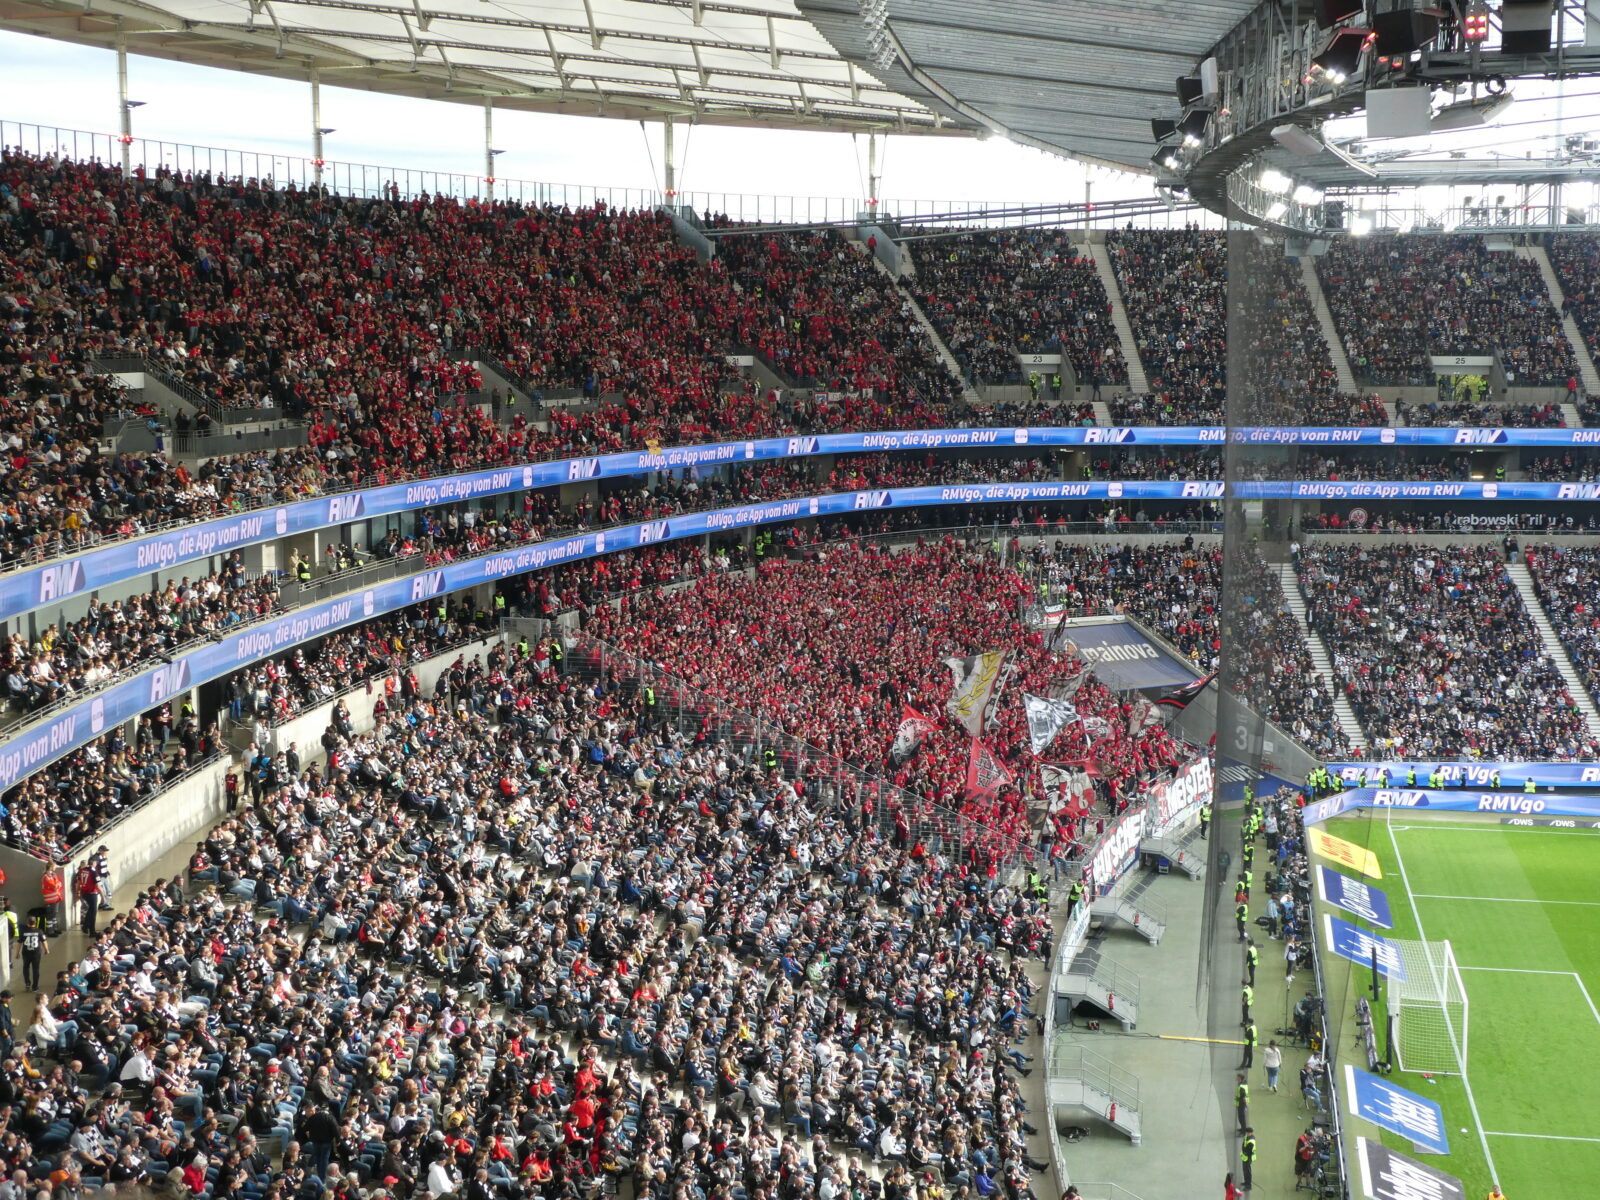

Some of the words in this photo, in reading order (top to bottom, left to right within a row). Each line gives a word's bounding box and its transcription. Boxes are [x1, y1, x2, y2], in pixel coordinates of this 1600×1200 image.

[903, 433, 918, 444] die
[921, 434, 941, 446] App
[944, 434, 969, 444] vom
[971, 430, 998, 443] RMV
[1084, 428, 1127, 443] RMV
[1250, 428, 1271, 441] die
[1272, 430, 1298, 444] App
[1301, 431, 1330, 441] vom
[1332, 430, 1362, 441] RMV
[1454, 429, 1503, 443] RMV
[670, 451, 681, 464] die
[683, 450, 697, 465] App
[699, 449, 716, 462] vom
[717, 445, 735, 459] RMV
[788, 438, 815, 454] RMV
[569, 459, 597, 479] RMV
[441, 480, 453, 497] die
[455, 480, 471, 497] App
[473, 478, 491, 492] vom
[492, 471, 512, 489] RMV
[987, 486, 1003, 497] die
[1007, 486, 1029, 499] App
[1032, 487, 1059, 497] vom
[1062, 484, 1091, 496] RMV
[1183, 483, 1224, 496] RMV
[1351, 484, 1371, 496] die
[1375, 485, 1399, 497] App
[1402, 486, 1431, 496] vom
[1434, 484, 1464, 496] RMV
[329, 495, 361, 522] RMV
[855, 491, 887, 508] RMV
[737, 510, 748, 522] die
[749, 508, 765, 524] App
[765, 506, 782, 520] vom
[783, 502, 800, 517] RMV
[179, 534, 194, 555] die
[196, 531, 215, 553] App
[218, 526, 238, 545] vom
[241, 517, 262, 541] RMV
[640, 521, 666, 542] RMV
[517, 553, 530, 569] die
[530, 550, 547, 569] App
[549, 547, 565, 560] vom
[567, 539, 585, 556] RMV
[40, 560, 80, 603] RMV
[412, 571, 442, 600] RMV
[276, 623, 289, 644] die
[291, 619, 308, 644] App
[311, 612, 331, 634] vom
[332, 600, 353, 626] RMV
[1080, 640, 1160, 663] mainova
[151, 659, 187, 702] RMV
[23, 736, 49, 768] vom
[51, 715, 76, 752] RMV
[1235, 725, 1248, 750] 3
[1373, 791, 1423, 807] RMV
[1479, 794, 1545, 814] RMVgo
[1514, 818, 1534, 826] DWS
[1555, 819, 1576, 827] DWS
[24, 936, 39, 948] 48
[1363, 1082, 1441, 1142] indeed
